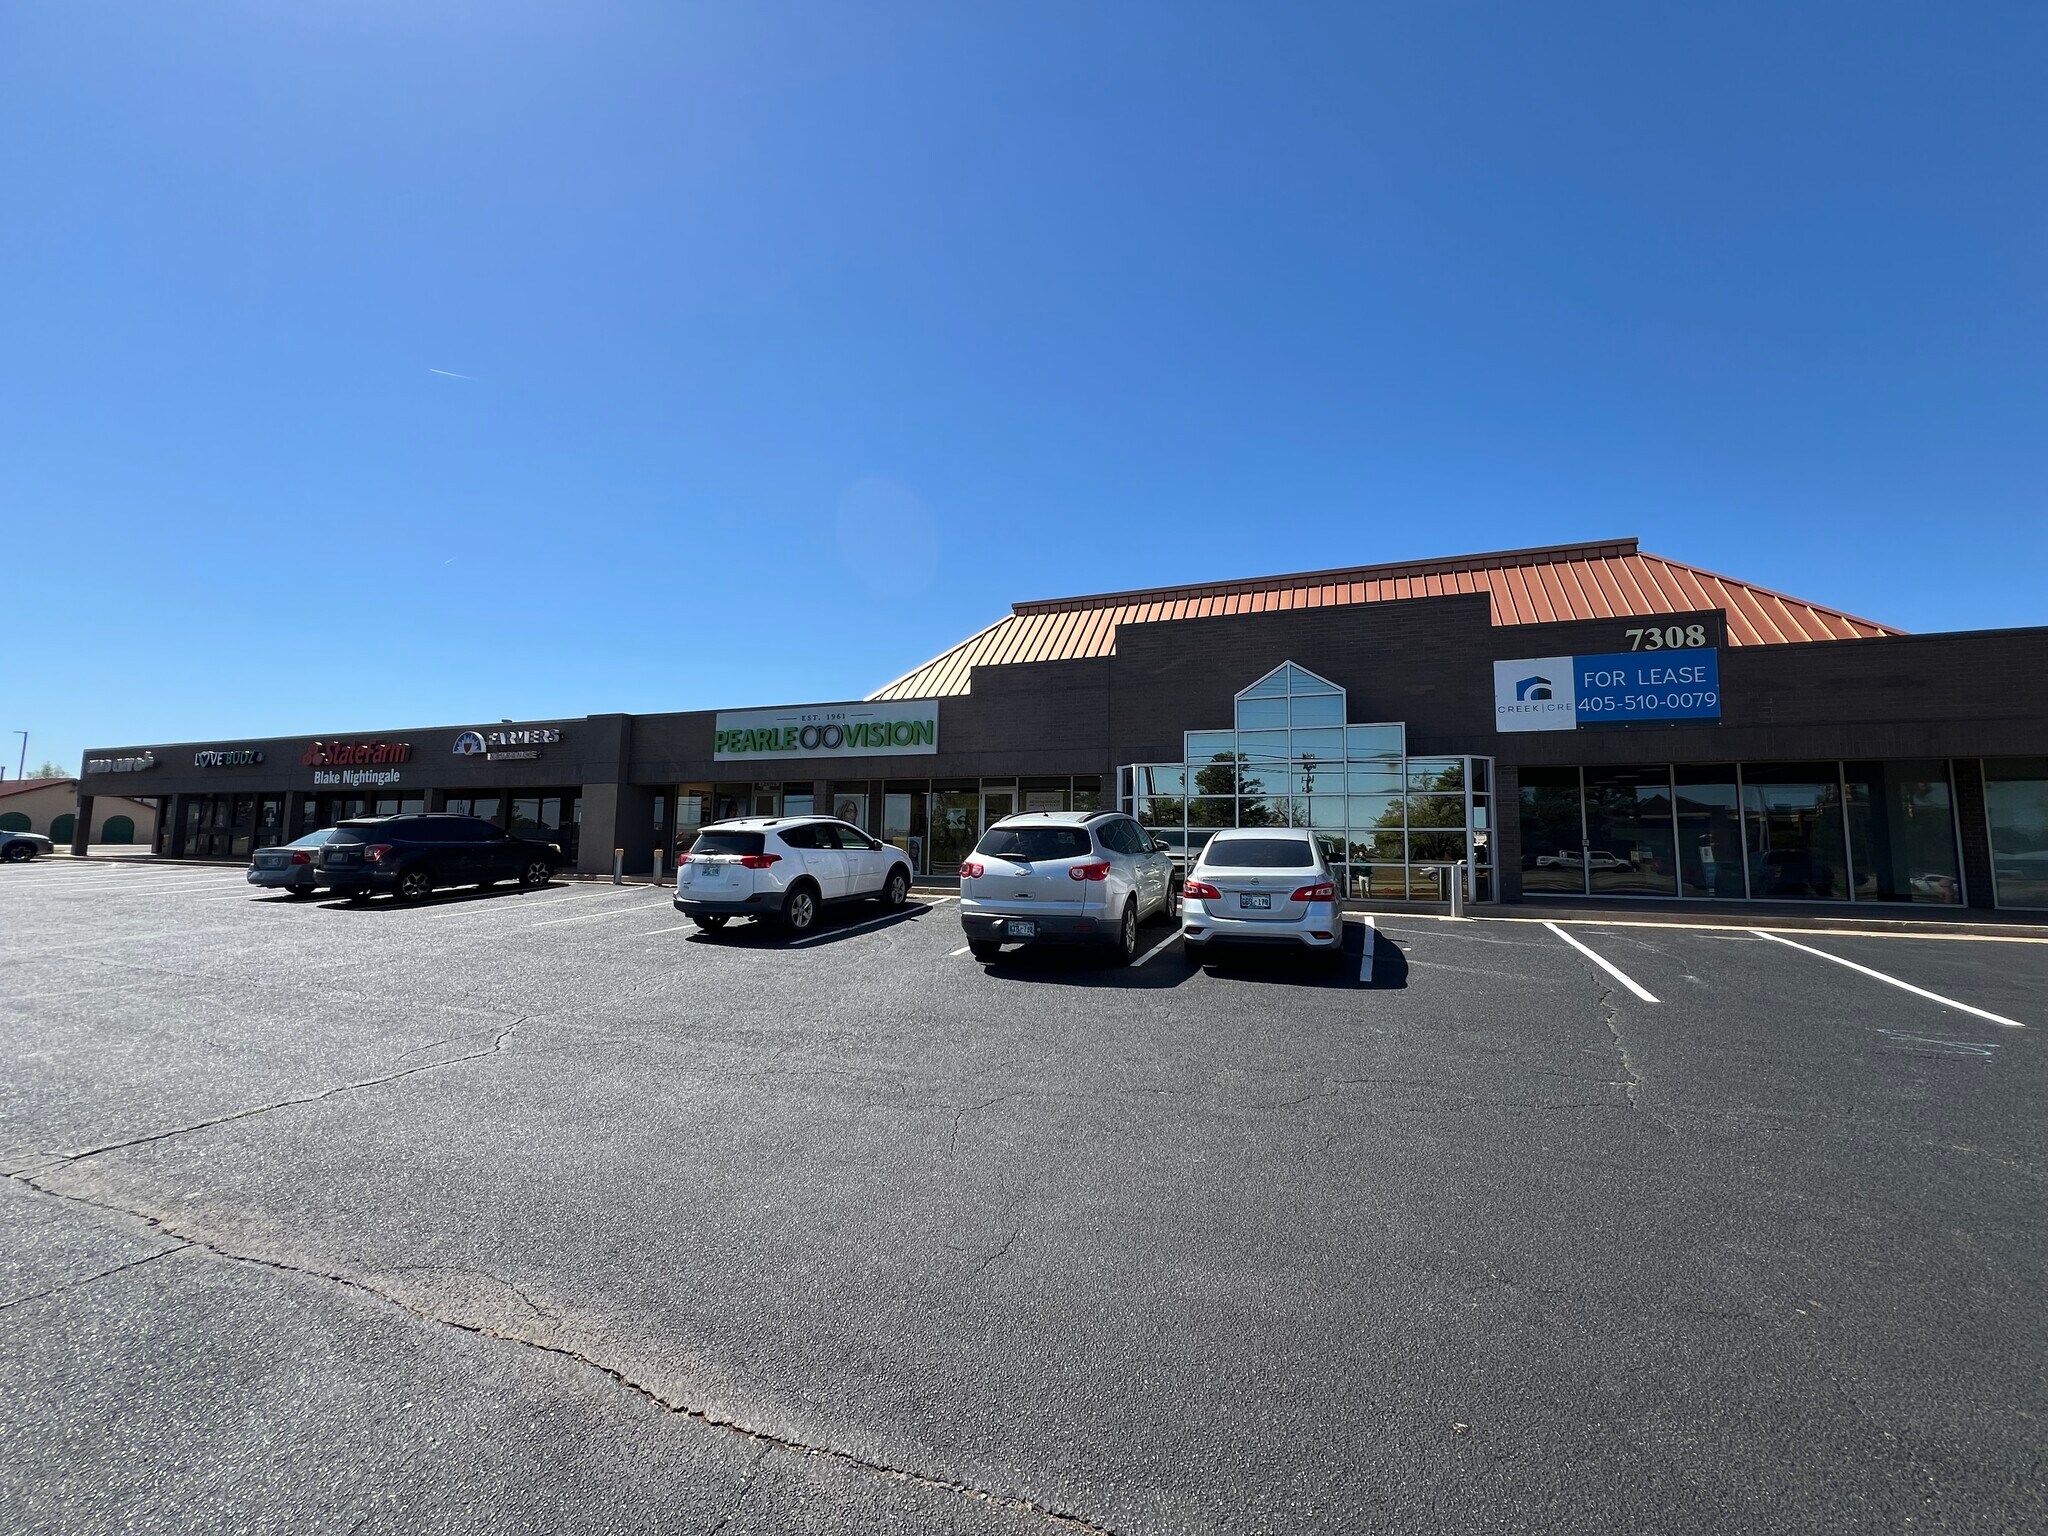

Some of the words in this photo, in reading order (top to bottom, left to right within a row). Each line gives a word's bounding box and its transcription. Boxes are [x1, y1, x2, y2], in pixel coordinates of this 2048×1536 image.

[1625, 624, 1706, 651] 7308
[1584, 670, 1626, 688] FOR
[1638, 666, 1707, 685] LEASE
[1498, 703, 1539, 713] CREEK
[1547, 702, 1573, 712] CRE
[1578, 691, 1717, 712] 405-510-0079
[488, 729, 560, 745] FARMERS
[714, 726, 798, 752] PEARLE
[842, 719, 934, 748] VISION
[225, 750, 255, 765] BUDZ
[314, 770, 340, 785] Blake
[343, 768, 400, 787] Nightingale
